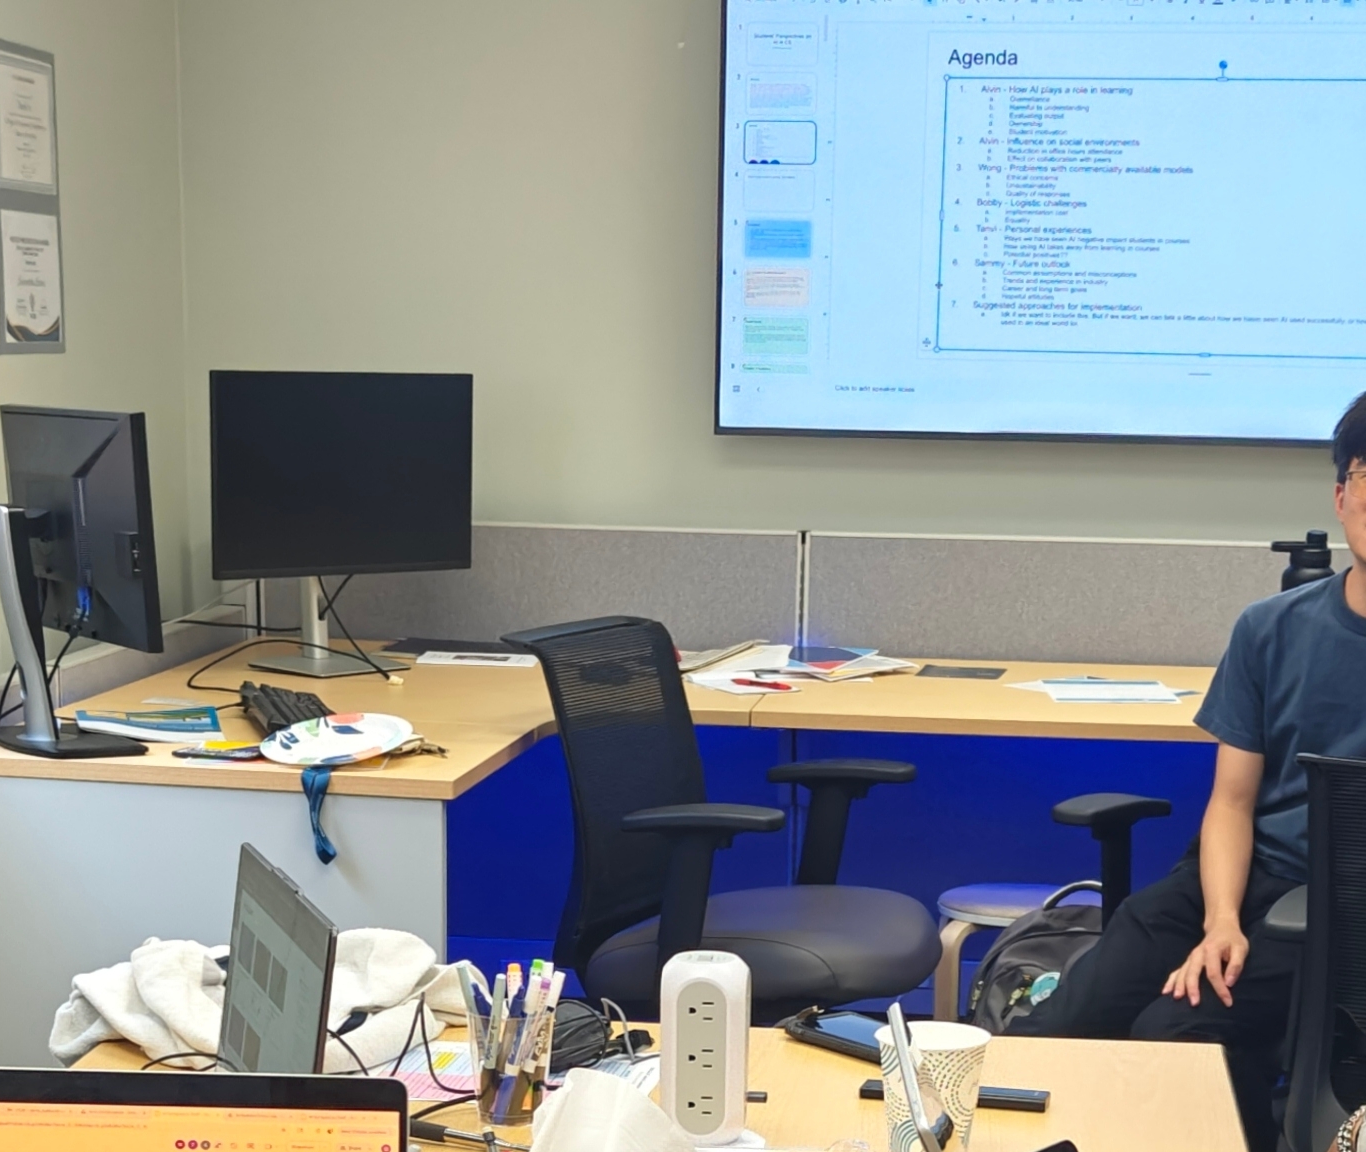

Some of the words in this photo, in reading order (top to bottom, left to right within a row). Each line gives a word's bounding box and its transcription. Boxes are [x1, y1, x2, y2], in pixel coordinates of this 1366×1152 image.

[948, 49, 1018, 69] Agenda
[1041, 86, 1061, 96] plays
[1073, 86, 1088, 94] role
[1091, 86, 1097, 94] in
[1101, 86, 1133, 96] learning
[1059, 138, 1082, 146] social
[1051, 165, 1067, 173] with
[1043, 201, 1087, 209] challenges
[1005, 226, 1040, 234] Personal
[1043, 227, 1092, 235] experiences
[1013, 260, 1039, 268] Future
[974, 301, 1015, 310] Suggested
[1018, 302, 1064, 311] approaches
[1068, 302, 1078, 310] for
[1081, 303, 1142, 312] implementation
